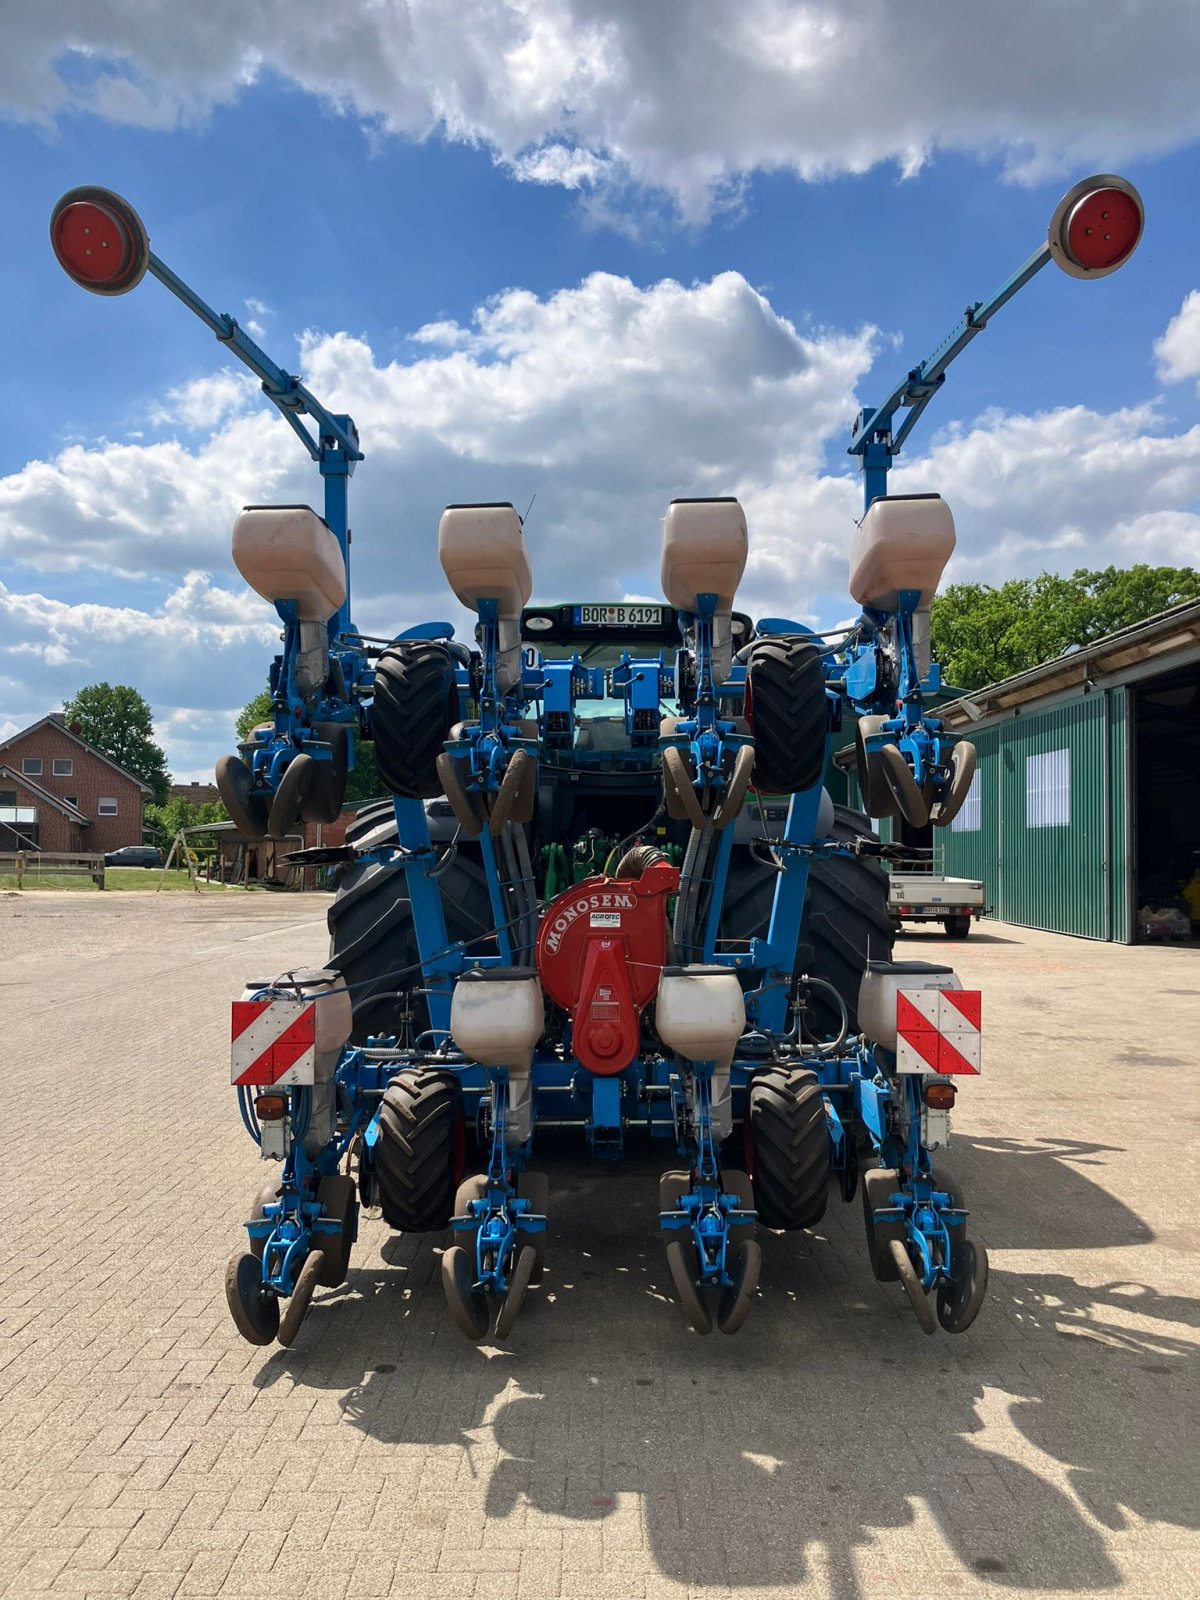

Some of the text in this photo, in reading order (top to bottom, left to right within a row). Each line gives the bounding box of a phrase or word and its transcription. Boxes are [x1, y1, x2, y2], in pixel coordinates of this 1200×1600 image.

[583, 608, 660, 623] BOR B 6191
[547, 895, 632, 951] MONOSEM
